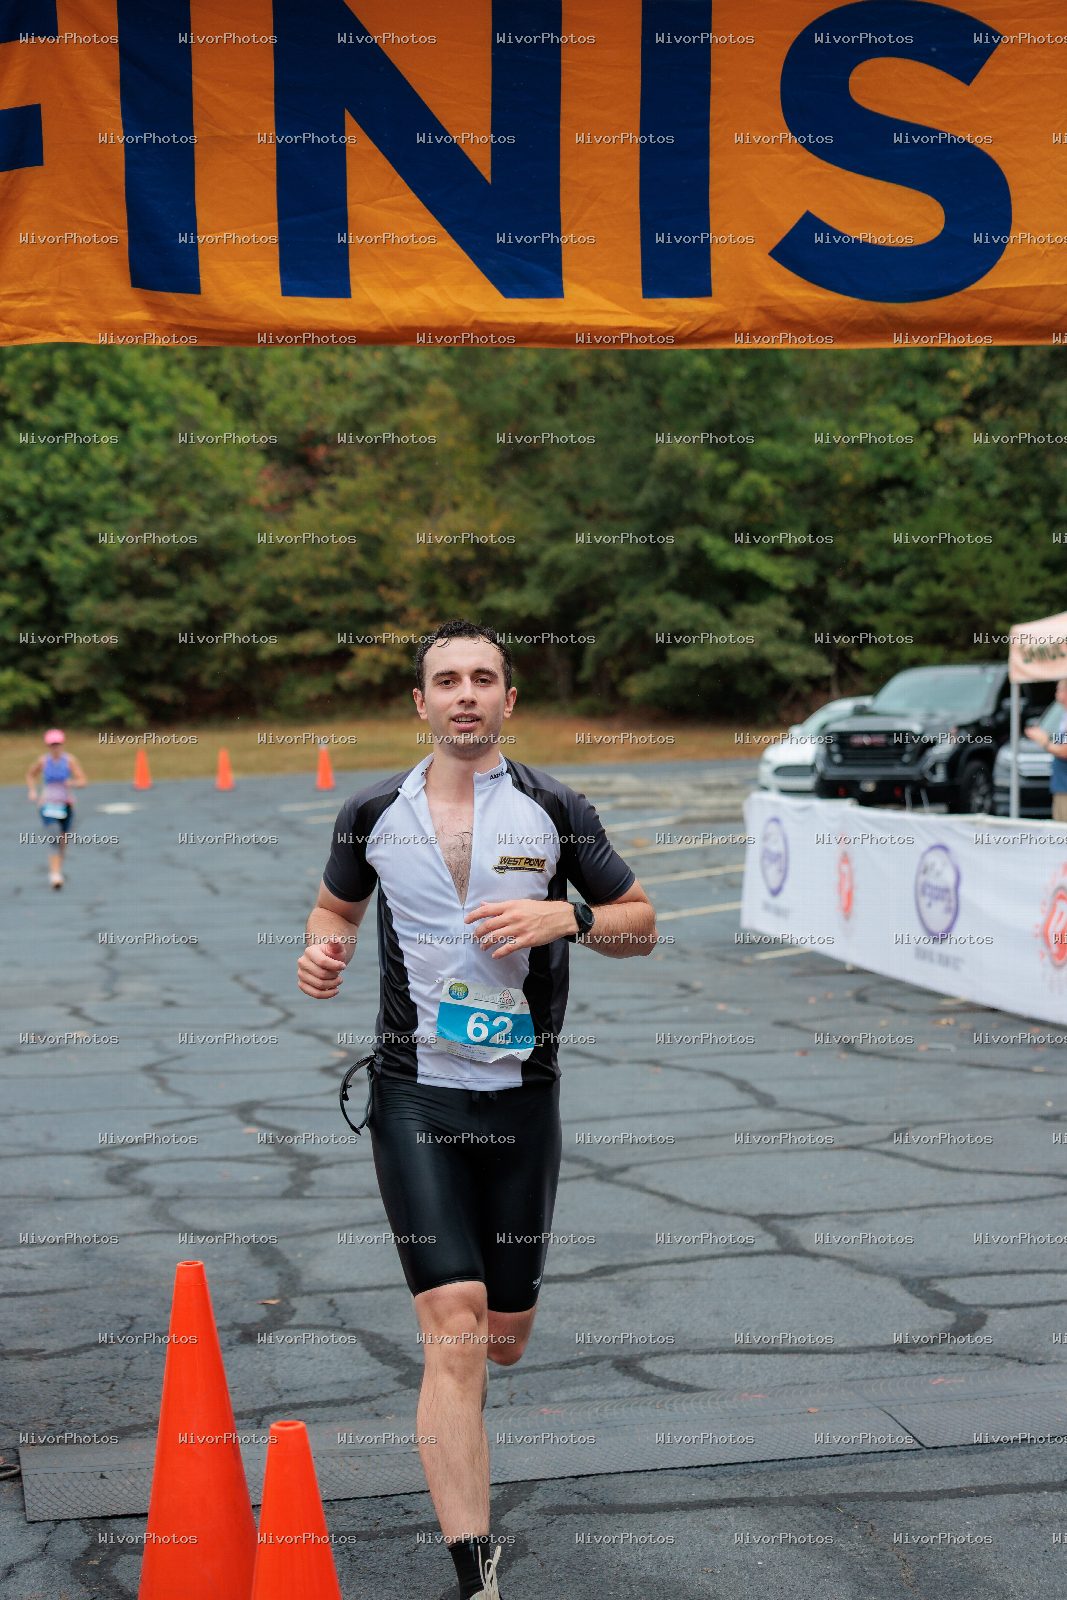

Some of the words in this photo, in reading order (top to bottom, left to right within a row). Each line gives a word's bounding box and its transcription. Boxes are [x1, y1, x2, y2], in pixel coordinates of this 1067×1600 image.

[0, 0, 1012, 303] INIS
[499, 856, 524, 866] WEST
[524, 857, 547, 869] POINT
[466, 1012, 514, 1045] 62
